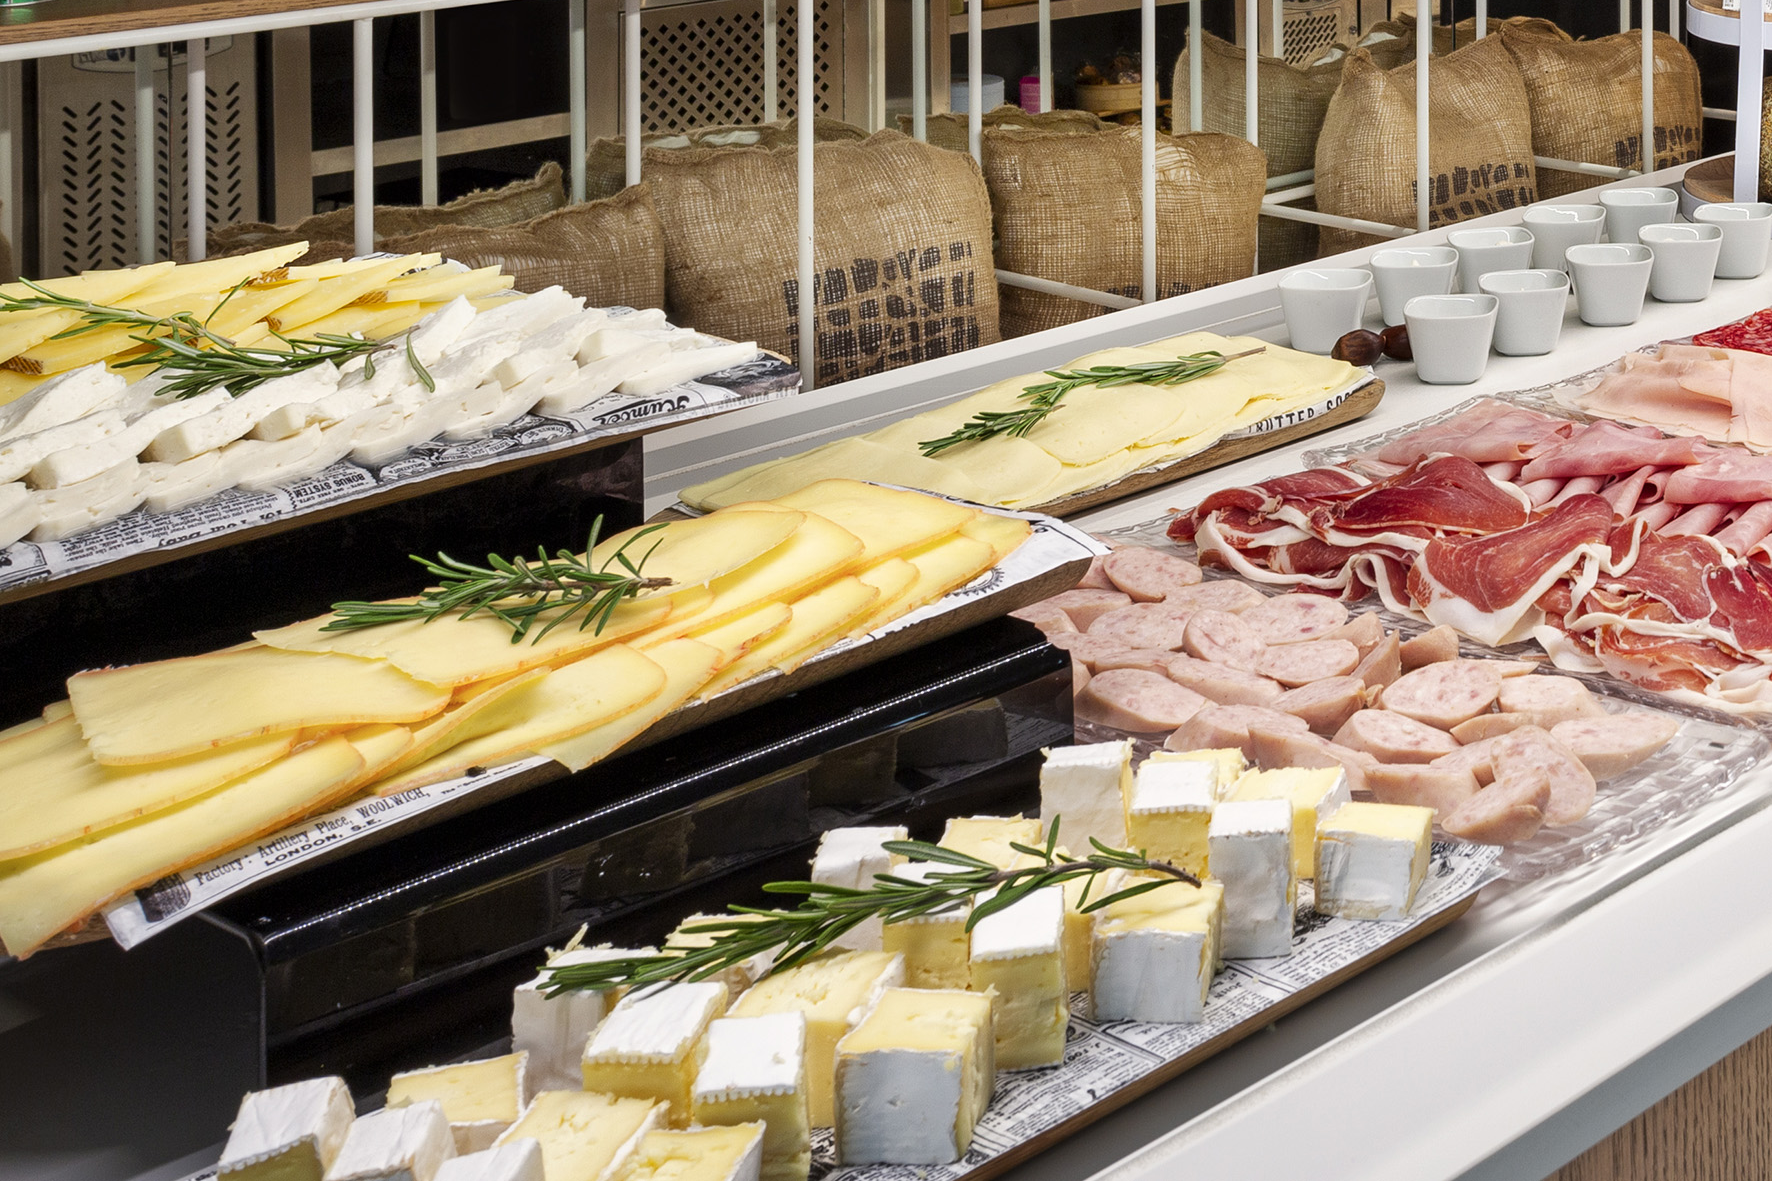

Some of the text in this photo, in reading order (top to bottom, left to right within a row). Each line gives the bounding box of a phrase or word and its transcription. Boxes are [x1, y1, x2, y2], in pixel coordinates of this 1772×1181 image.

[333, 472, 366, 490] BONUS
[292, 482, 333, 499] SYSTEM
[245, 502, 272, 514] Perhaps
[138, 523, 153, 531] you
[154, 519, 173, 527] Then
[122, 528, 137, 536] will
[107, 542, 124, 551] take
[125, 537, 144, 546] Then
[258, 828, 310, 859] Artillery
[314, 812, 354, 833] Place,
[356, 787, 430, 820] WOOLWICH,
[350, 818, 382, 833] S.E.
